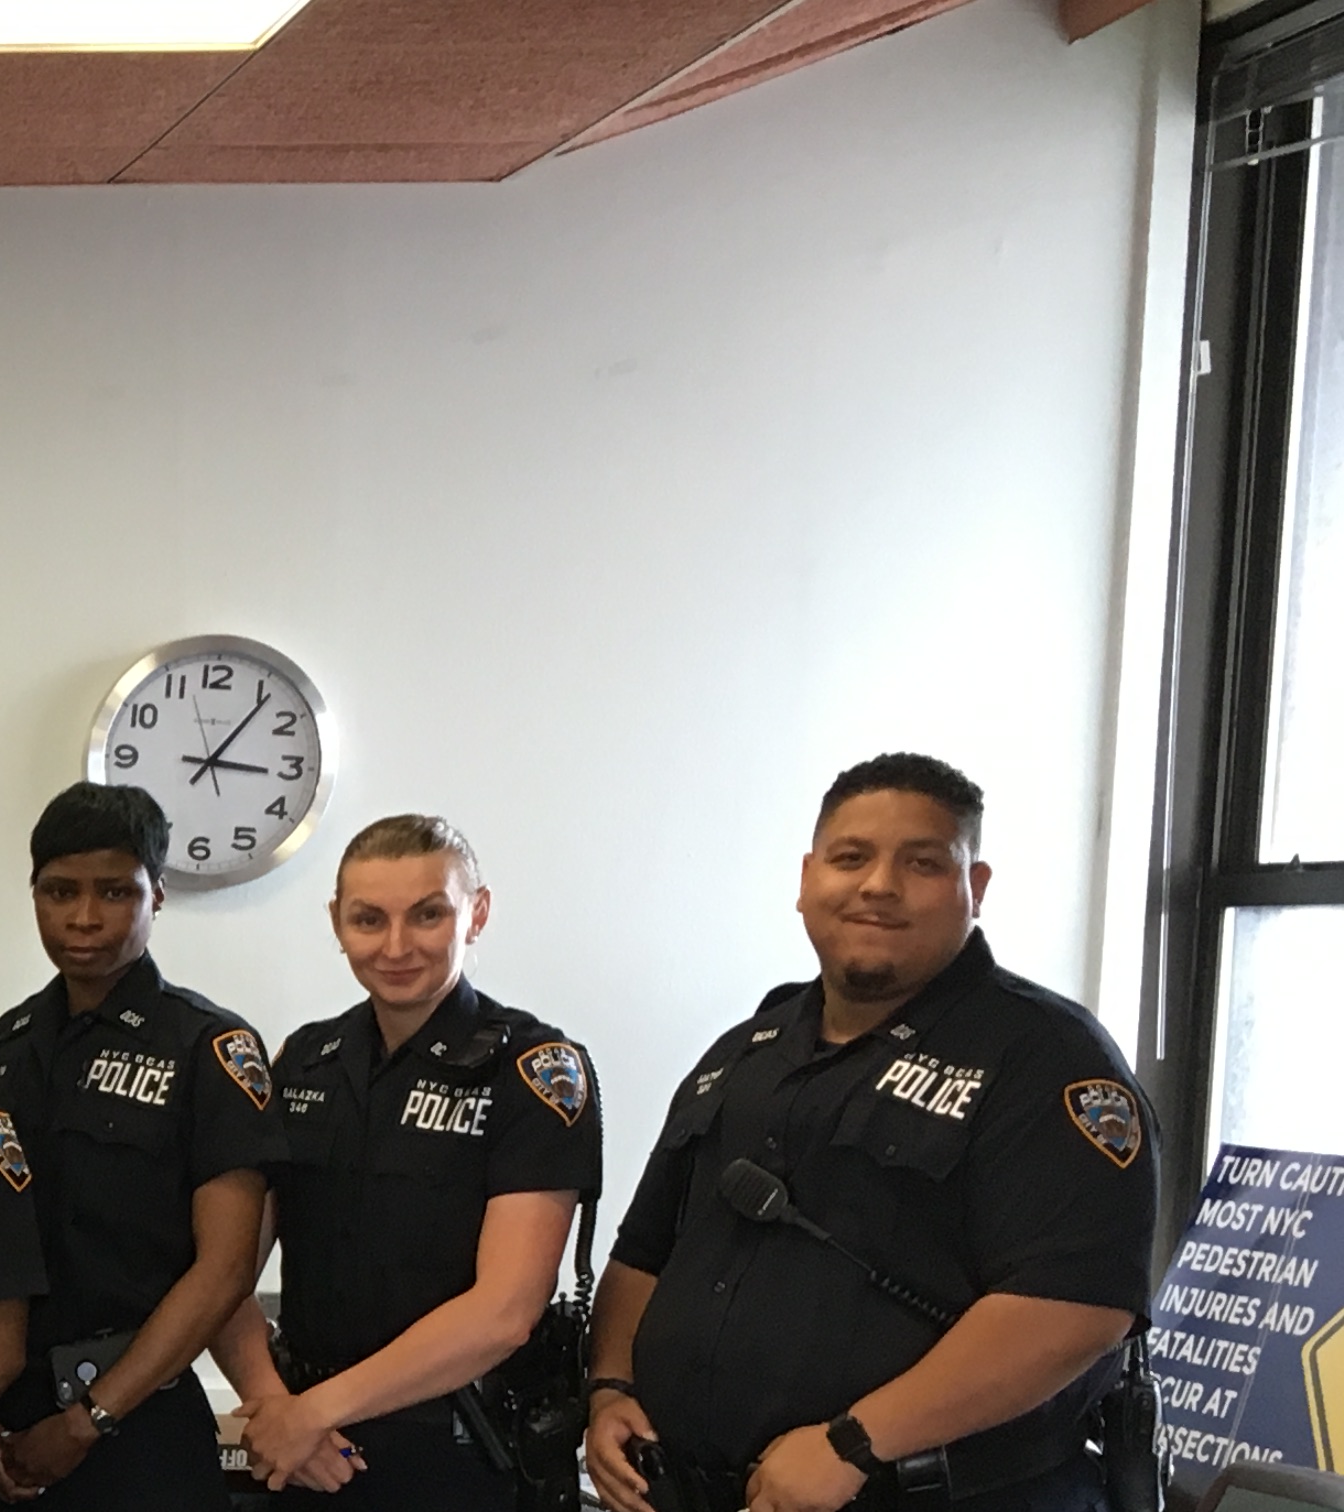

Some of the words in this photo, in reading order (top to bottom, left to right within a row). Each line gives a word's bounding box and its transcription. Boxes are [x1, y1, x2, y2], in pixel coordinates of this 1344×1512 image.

[165, 673, 187, 699] 11
[202, 664, 234, 691] 12
[130, 703, 158, 729] 10
[272, 711, 298, 736] 2
[114, 744, 140, 769] 9
[277, 755, 305, 781] 3
[264, 796, 288, 820] 4
[188, 836, 211, 861] 6
[231, 827, 257, 851] 5
[100, 1048, 130, 1061] NYC
[135, 1055, 175, 1069] DCAS
[903, 1052, 940, 1069] NYC
[87, 1058, 175, 1106] POLICE
[416, 1078, 449, 1094] NYC
[875, 1059, 982, 1120] POLICE
[400, 1090, 493, 1136] POLICE
[1217, 1155, 1281, 1188] TURN
[1195, 1197, 1265, 1233] MOST
[1260, 1206, 1314, 1239] NYC
[1177, 1241, 1319, 1289] PEDESTRIAN
[1160, 1284, 1262, 1327] INJURIES
[1258, 1302, 1315, 1337] AND
[1146, 1326, 1262, 1376] FATALITIES
[1202, 1387, 1238, 1419] AT
